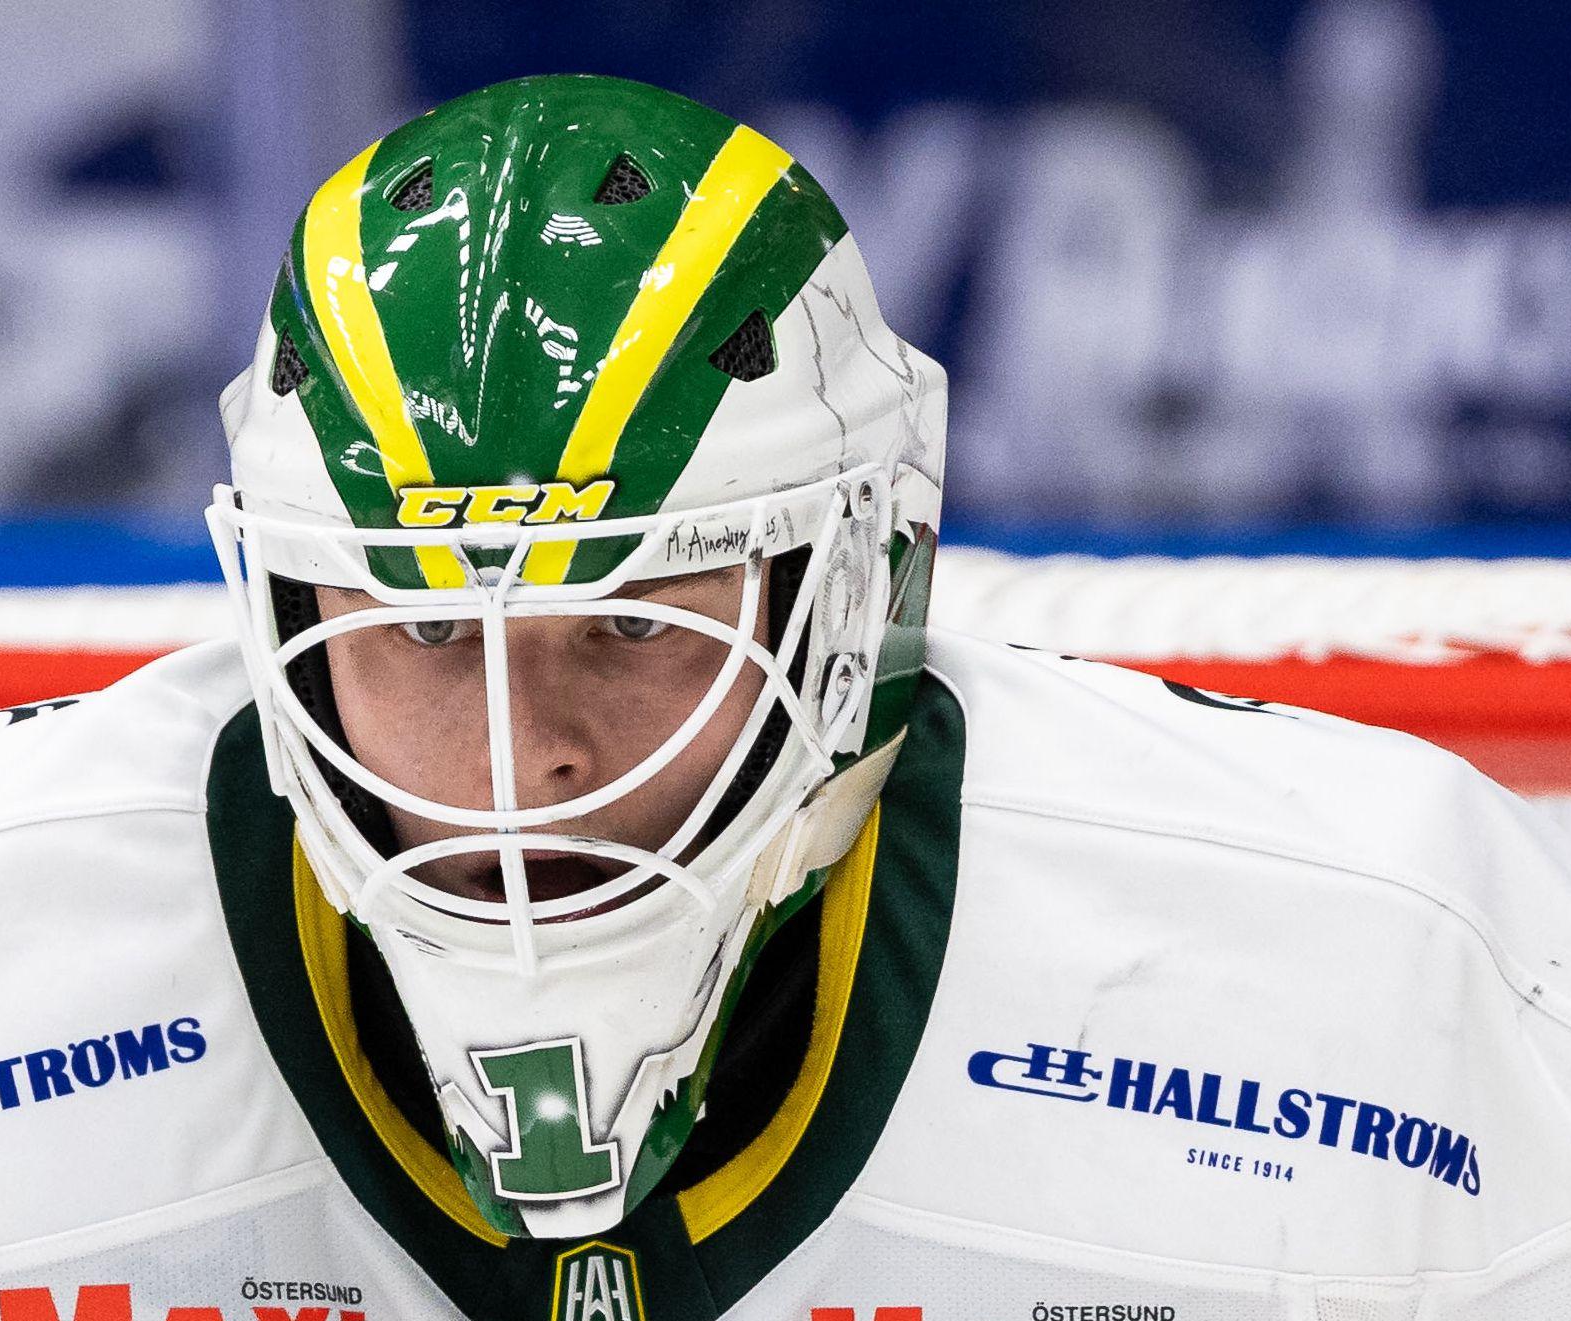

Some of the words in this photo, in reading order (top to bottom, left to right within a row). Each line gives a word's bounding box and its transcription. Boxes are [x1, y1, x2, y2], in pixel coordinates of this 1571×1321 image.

[396, 480, 615, 527] CCM
[469, 1036, 621, 1201] 1
[1106, 1057, 1481, 1197] HALLSTRÖMS
[1187, 1147, 1243, 1174] SINCE
[1253, 1159, 1295, 1183] 1914
[242, 1276, 363, 1305] ÖSTERSUND
